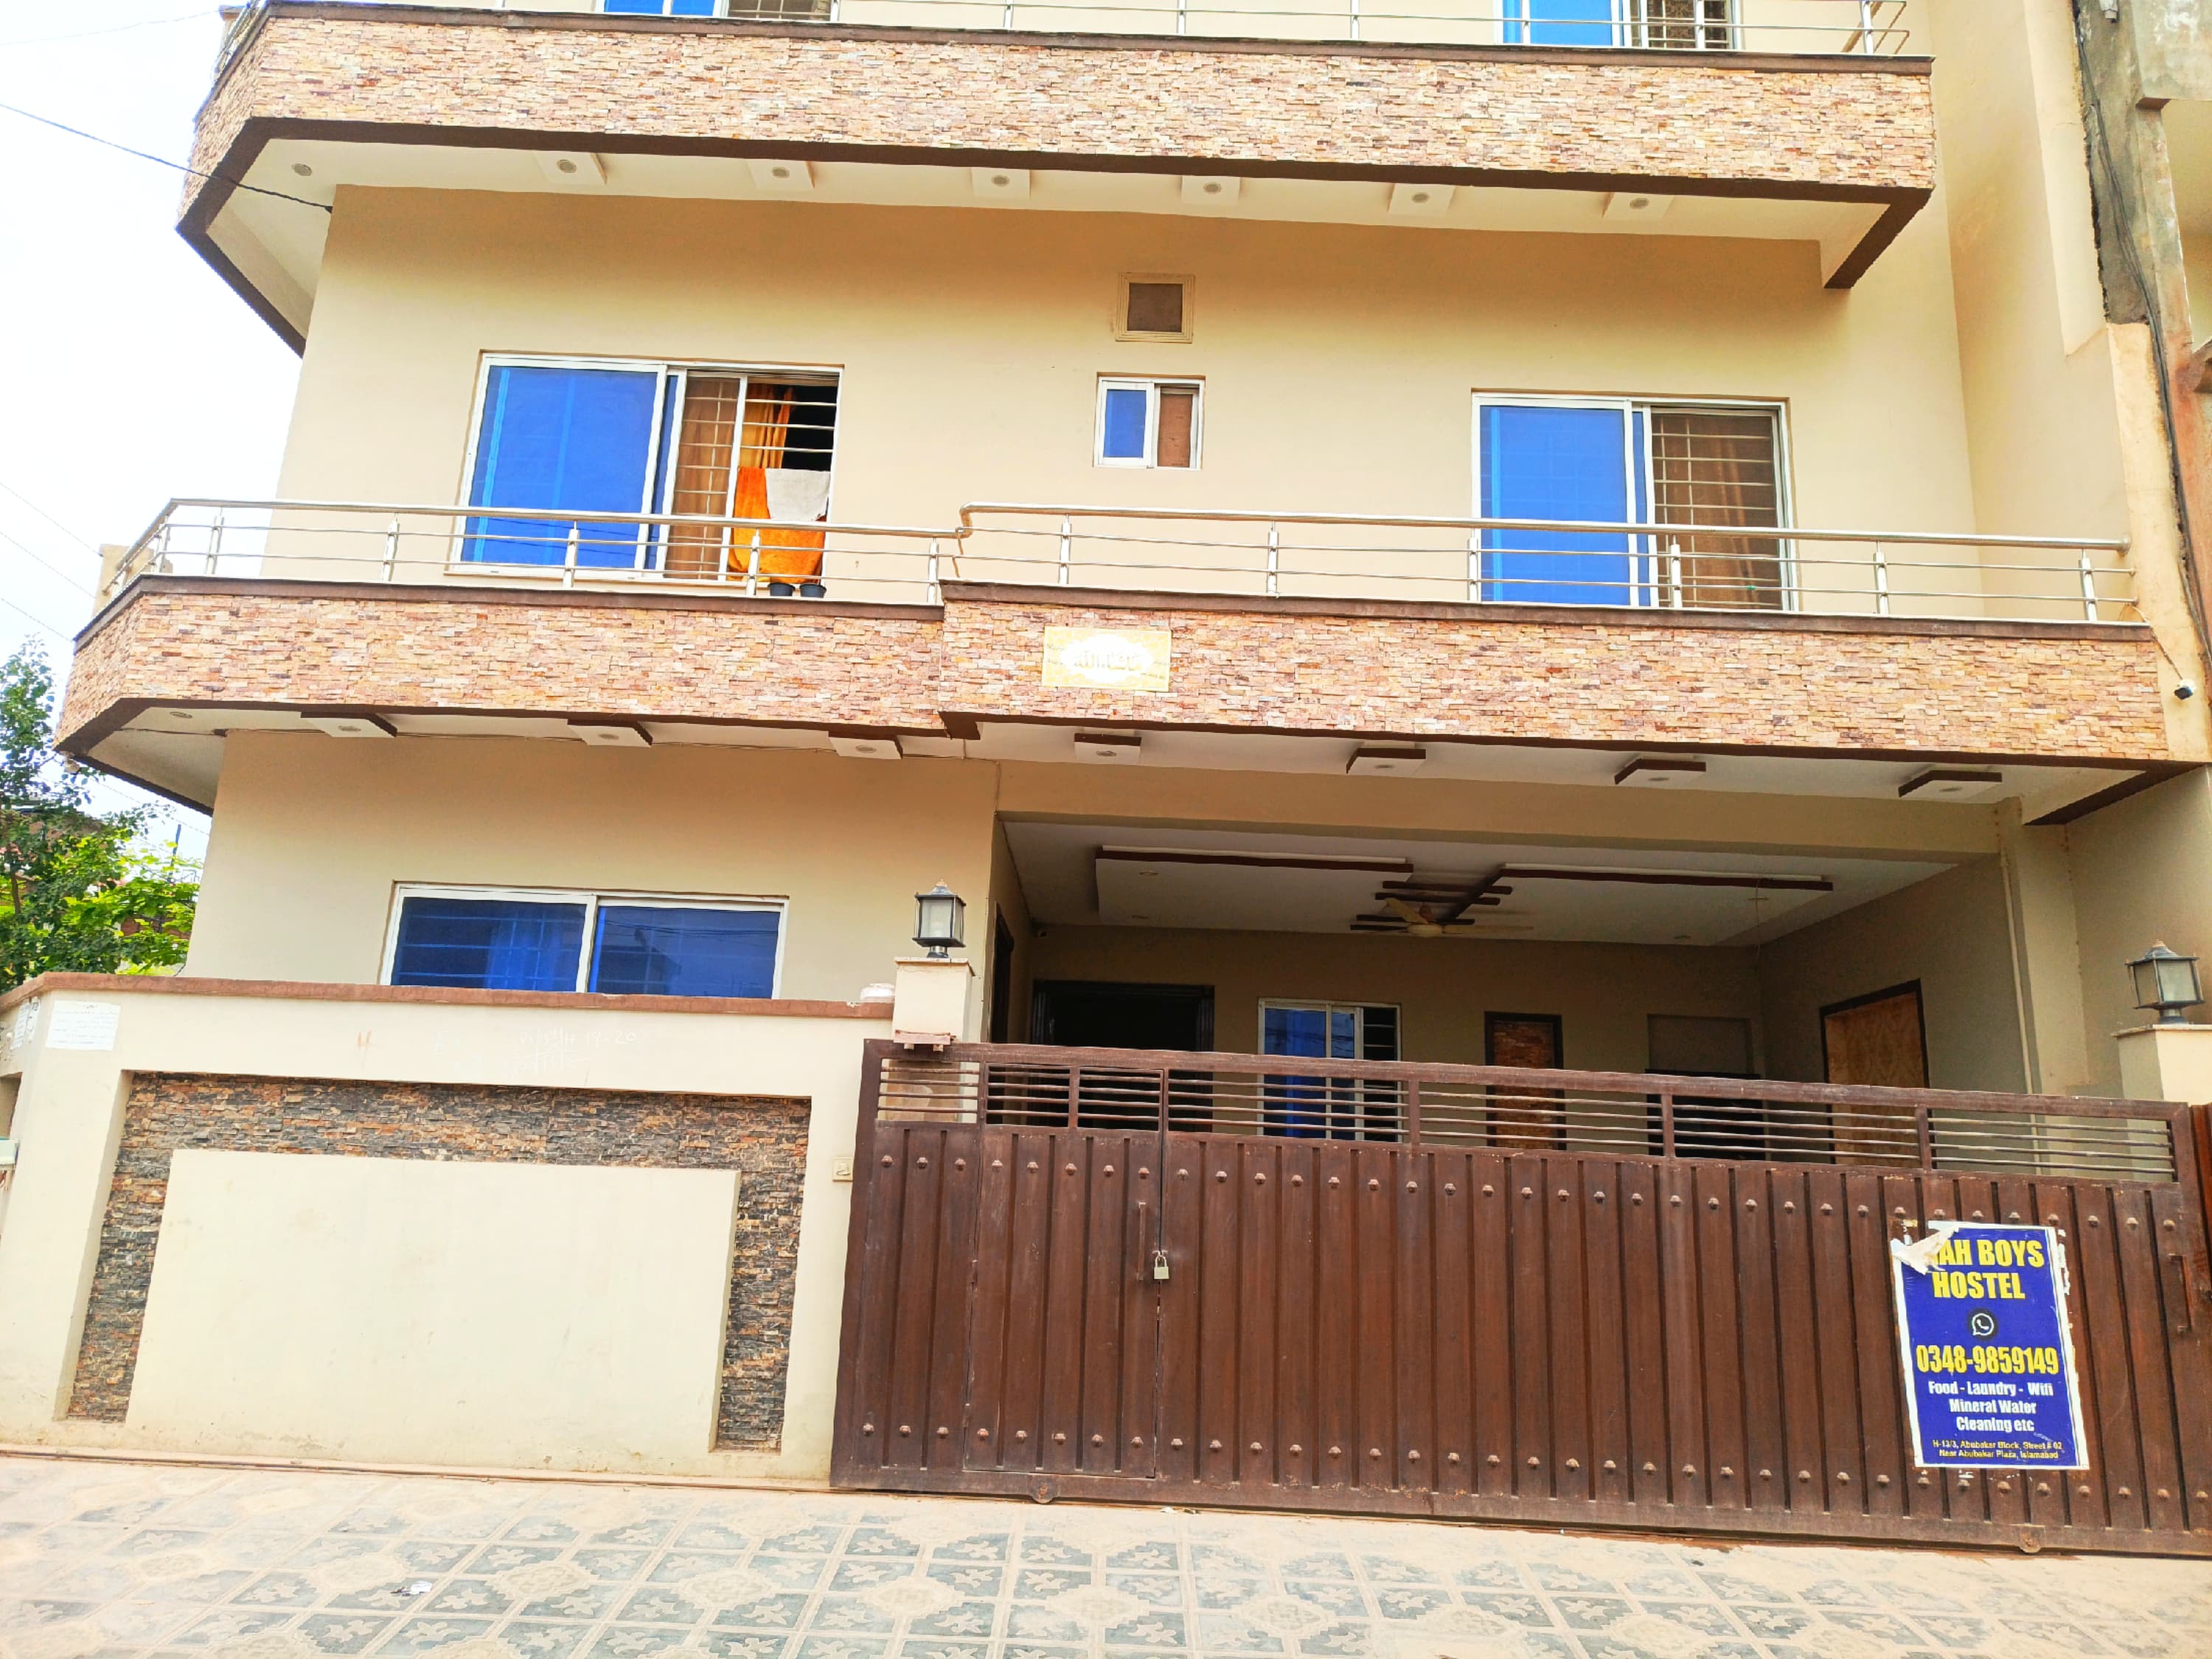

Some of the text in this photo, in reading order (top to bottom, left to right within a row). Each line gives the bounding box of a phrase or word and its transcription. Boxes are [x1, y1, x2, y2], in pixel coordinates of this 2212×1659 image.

[1934, 1239, 2045, 1268] AH BOYS
[1932, 1271, 2025, 1298] HOSTEL
[1916, 1346, 2059, 1374] 0348-9859149
[1928, 1381, 1958, 1394] Food
[1967, 1382, 2017, 1397] Laundry
[1949, 1399, 2037, 1414] Mineral Water
[1956, 1416, 2035, 1433] Cleaning etc
